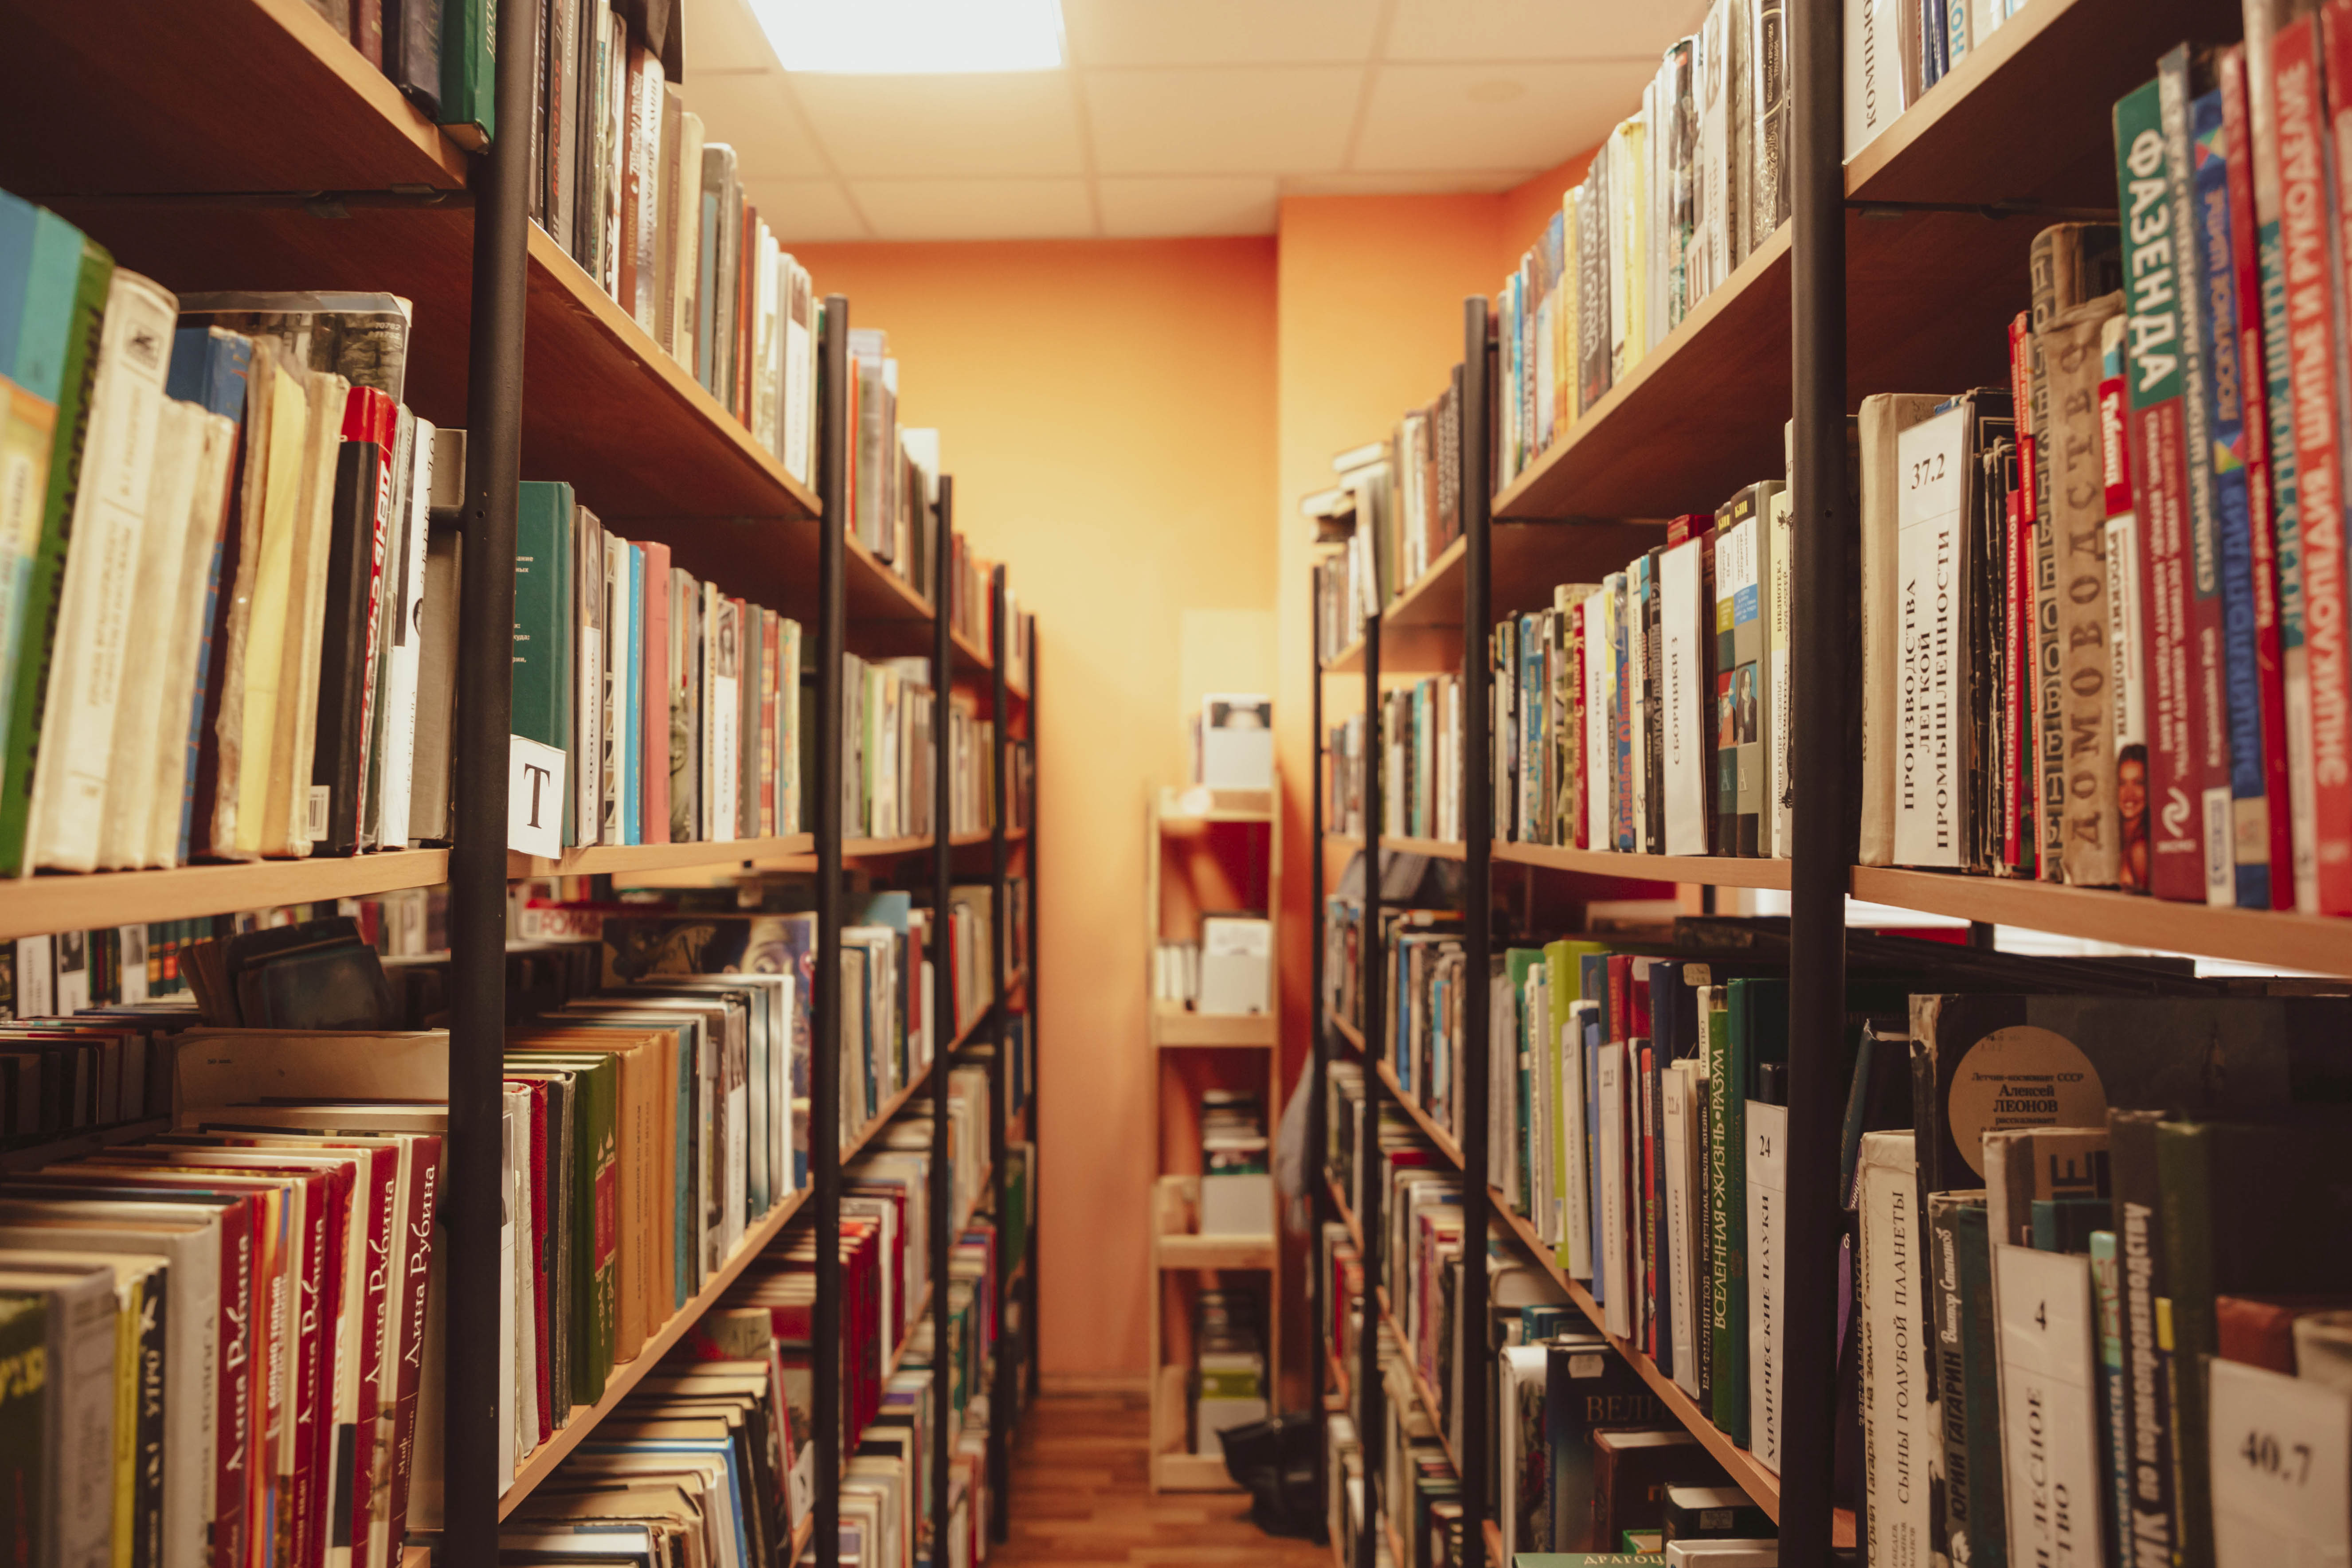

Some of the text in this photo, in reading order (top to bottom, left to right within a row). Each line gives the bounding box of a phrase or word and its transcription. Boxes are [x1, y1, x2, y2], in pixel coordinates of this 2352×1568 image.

[2127, 128, 2178, 392] ФАЗЕНДА
[373, 459, 391, 568] ДЕНЬ
[1911, 453, 1946, 490] 37.2
[2009, 514, 2017, 598] МАТЕРИАЛОВ
[2059, 342, 2105, 851] ДОМОВОДСТВО
[1903, 577, 1917, 810] ПРОИЗВОДСТВА
[1917, 631, 1932, 754] ЛЕГКОЙ
[1934, 530, 1950, 849] ПРОМЫШЛЕННОСТИ
[2008, 602, 2017, 681] ПРИРОДНЫХ
[2008, 684, 2015, 701] ИЗ
[2220, 489, 2259, 783] ЭНЦИКЛОПЕДИЯ
[1671, 636, 1680, 765] СБОРНИКИ 3
[524, 762, 551, 830] Т
[2005, 782, 2014, 840] ФИГУРКИ
[2006, 767, 2014, 778] И
[1993, 1099, 2058, 1113] ЛЕОНОВ
[1999, 1083, 2055, 1097] Алексей
[2057, 1073, 2084, 1082] СССР
[1712, 1048, 1727, 1329] ВСЕЛЕННАЯ ЖИЗНЬ РАЗУМ
[1759, 1134, 1771, 1158] 24
[225, 1233, 249, 1371] Рубина
[300, 1219, 323, 1337] Рубина
[364, 1178, 395, 1384] Дина Рубина
[404, 1164, 437, 1369] Дина Рубина
[1935, 1227, 1962, 1344] Виктор Степанов
[2035, 1301, 2047, 1331] 4
[1761, 1194, 1775, 1462] ХИМИЧЕСКИЕ НАУКИ
[1892, 1191, 1909, 1504] СЫНЫ ГОЛУБОЙ ПЛАНЕТЫ
[2124, 1202, 2164, 1462] кормопроизводству
[1942, 1352, 1967, 1521] ЮРИЙ ГАГАРИН
[2027, 1387, 2048, 1541] ЛЕСНОЕ
[2136, 1466, 2160, 1502] по
[2240, 1427, 2312, 1487] 40.7
